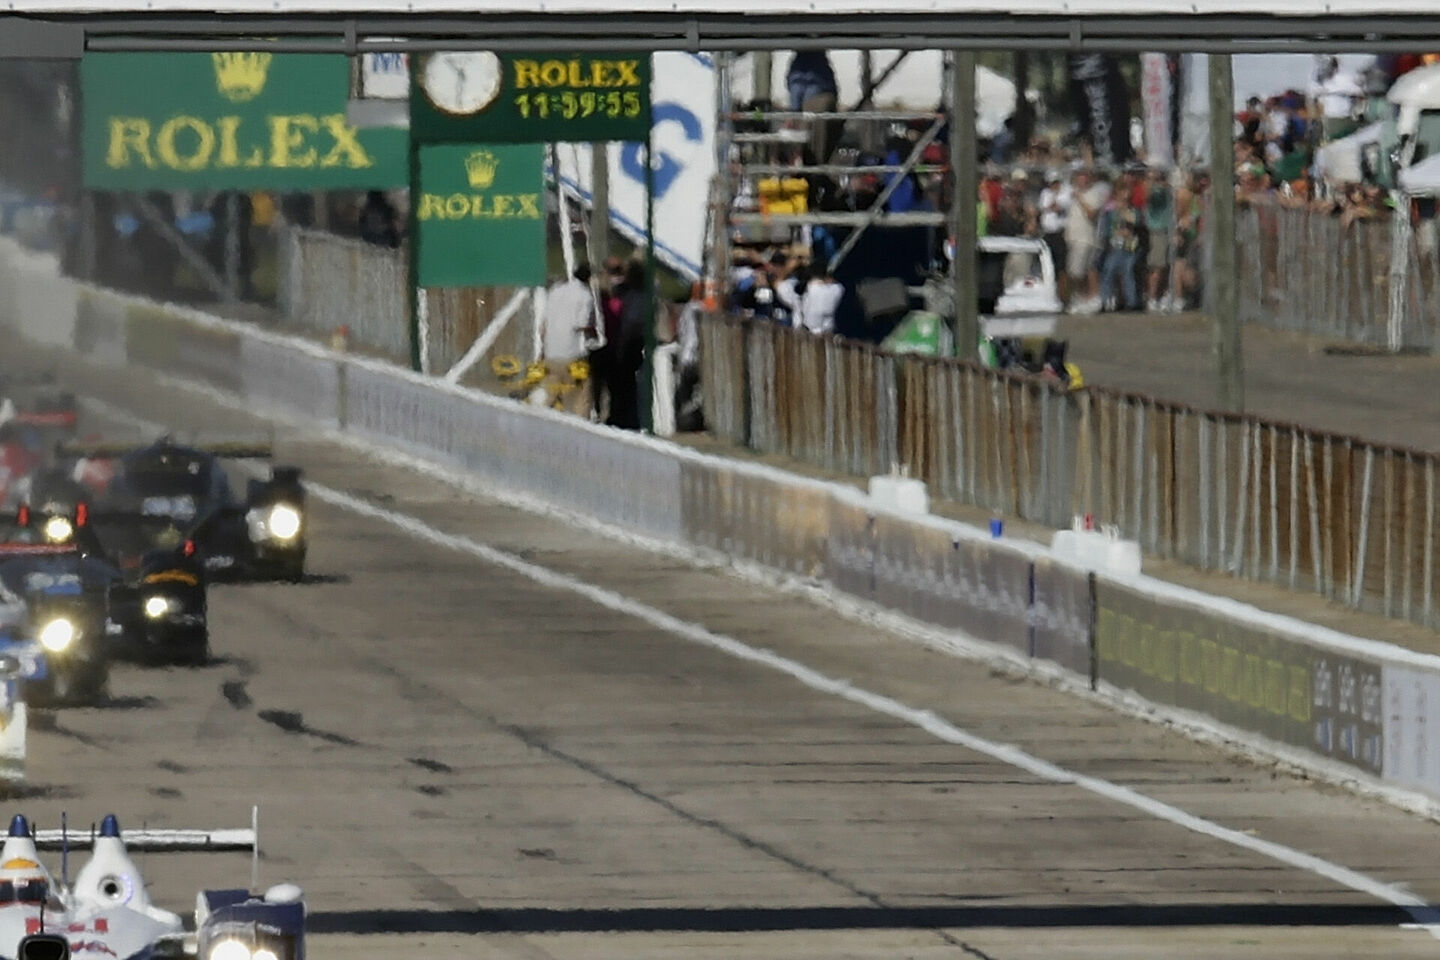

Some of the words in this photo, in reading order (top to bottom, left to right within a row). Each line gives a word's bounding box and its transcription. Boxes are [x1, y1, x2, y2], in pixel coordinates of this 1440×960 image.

[514, 60, 641, 88] ROLEX
[105, 113, 374, 171] ROLEX
[417, 192, 540, 220] ROLEX
